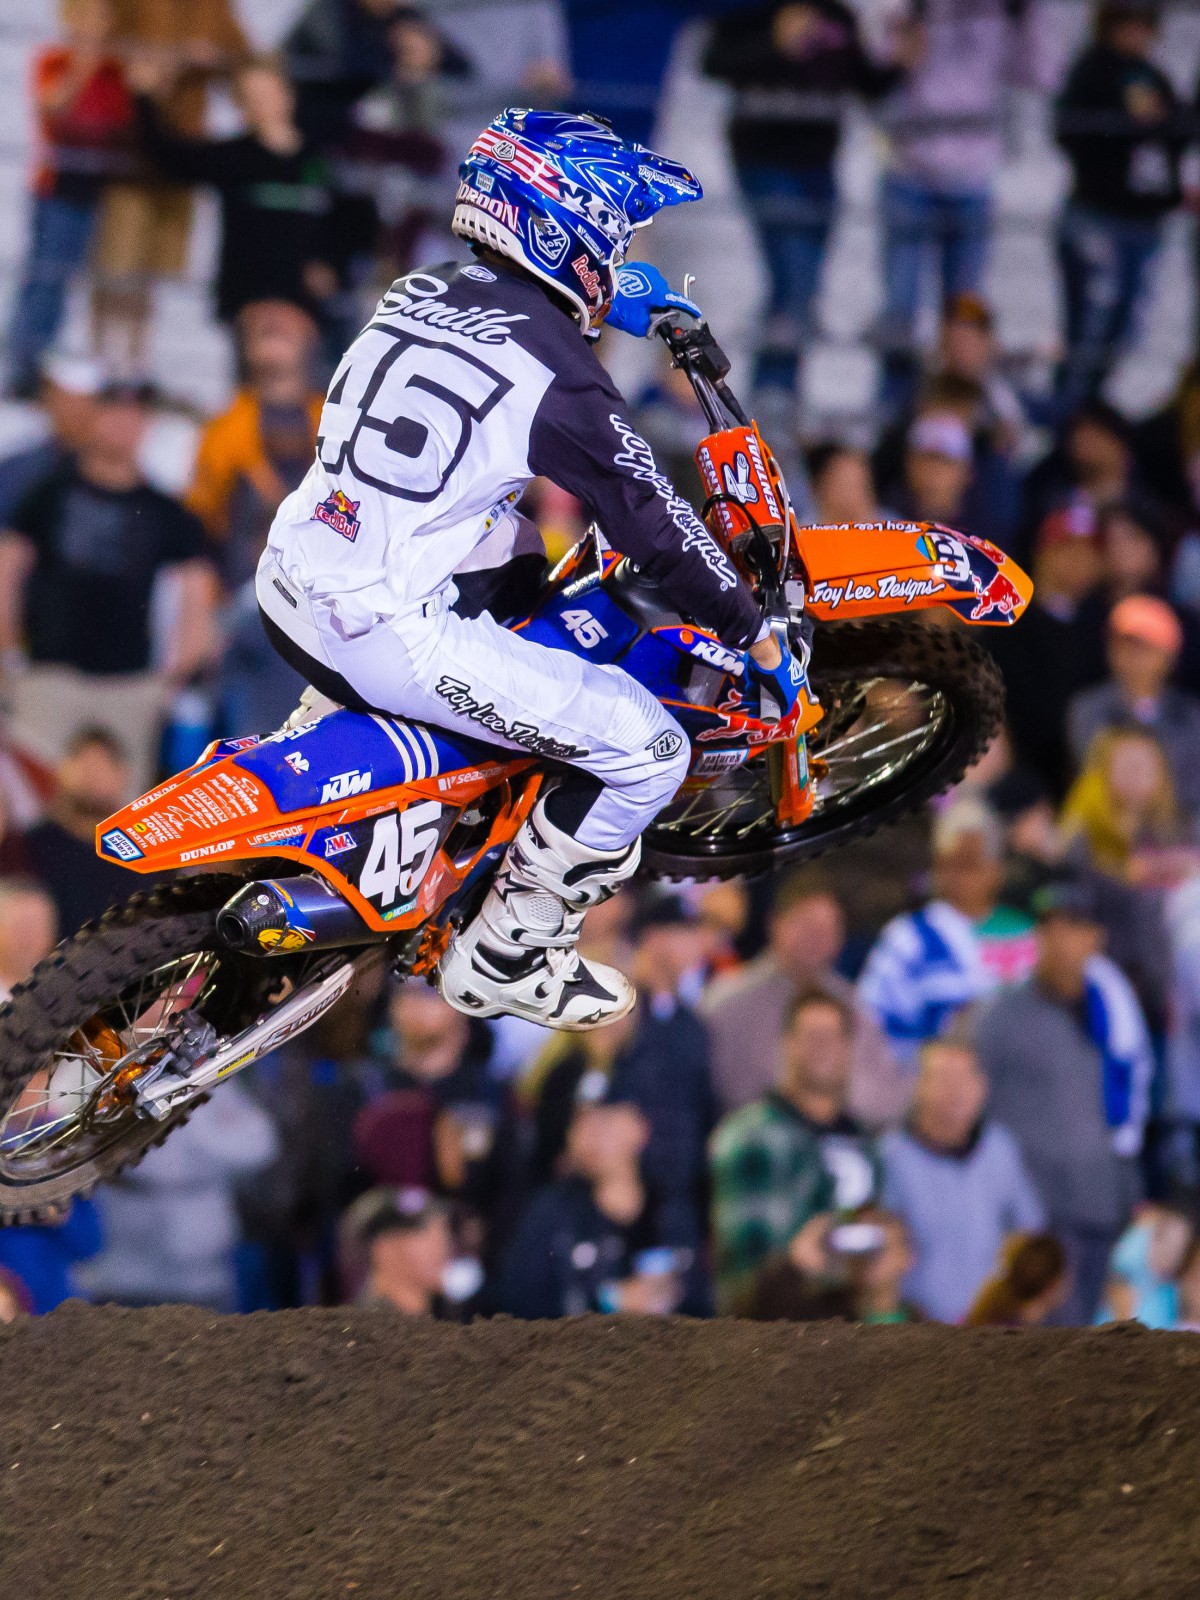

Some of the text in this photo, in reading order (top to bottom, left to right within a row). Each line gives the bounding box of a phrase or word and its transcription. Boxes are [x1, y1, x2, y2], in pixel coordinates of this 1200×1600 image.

[377, 274, 530, 344] Smith
[317, 322, 514, 503] 45
[845, 579, 876, 602] Lee
[878, 575, 945, 603] Designs
[560, 610, 609, 648] 45
[690, 640, 745, 677] KTM
[435, 675, 478, 717] Troy
[470, 703, 507, 735] Lee
[320, 770, 372, 804] KTM
[180, 840, 236, 862] DUNLOP
[247, 824, 304, 846] LIFEPROOF
[327, 833, 355, 854] AMA
[359, 800, 441, 907] 45
